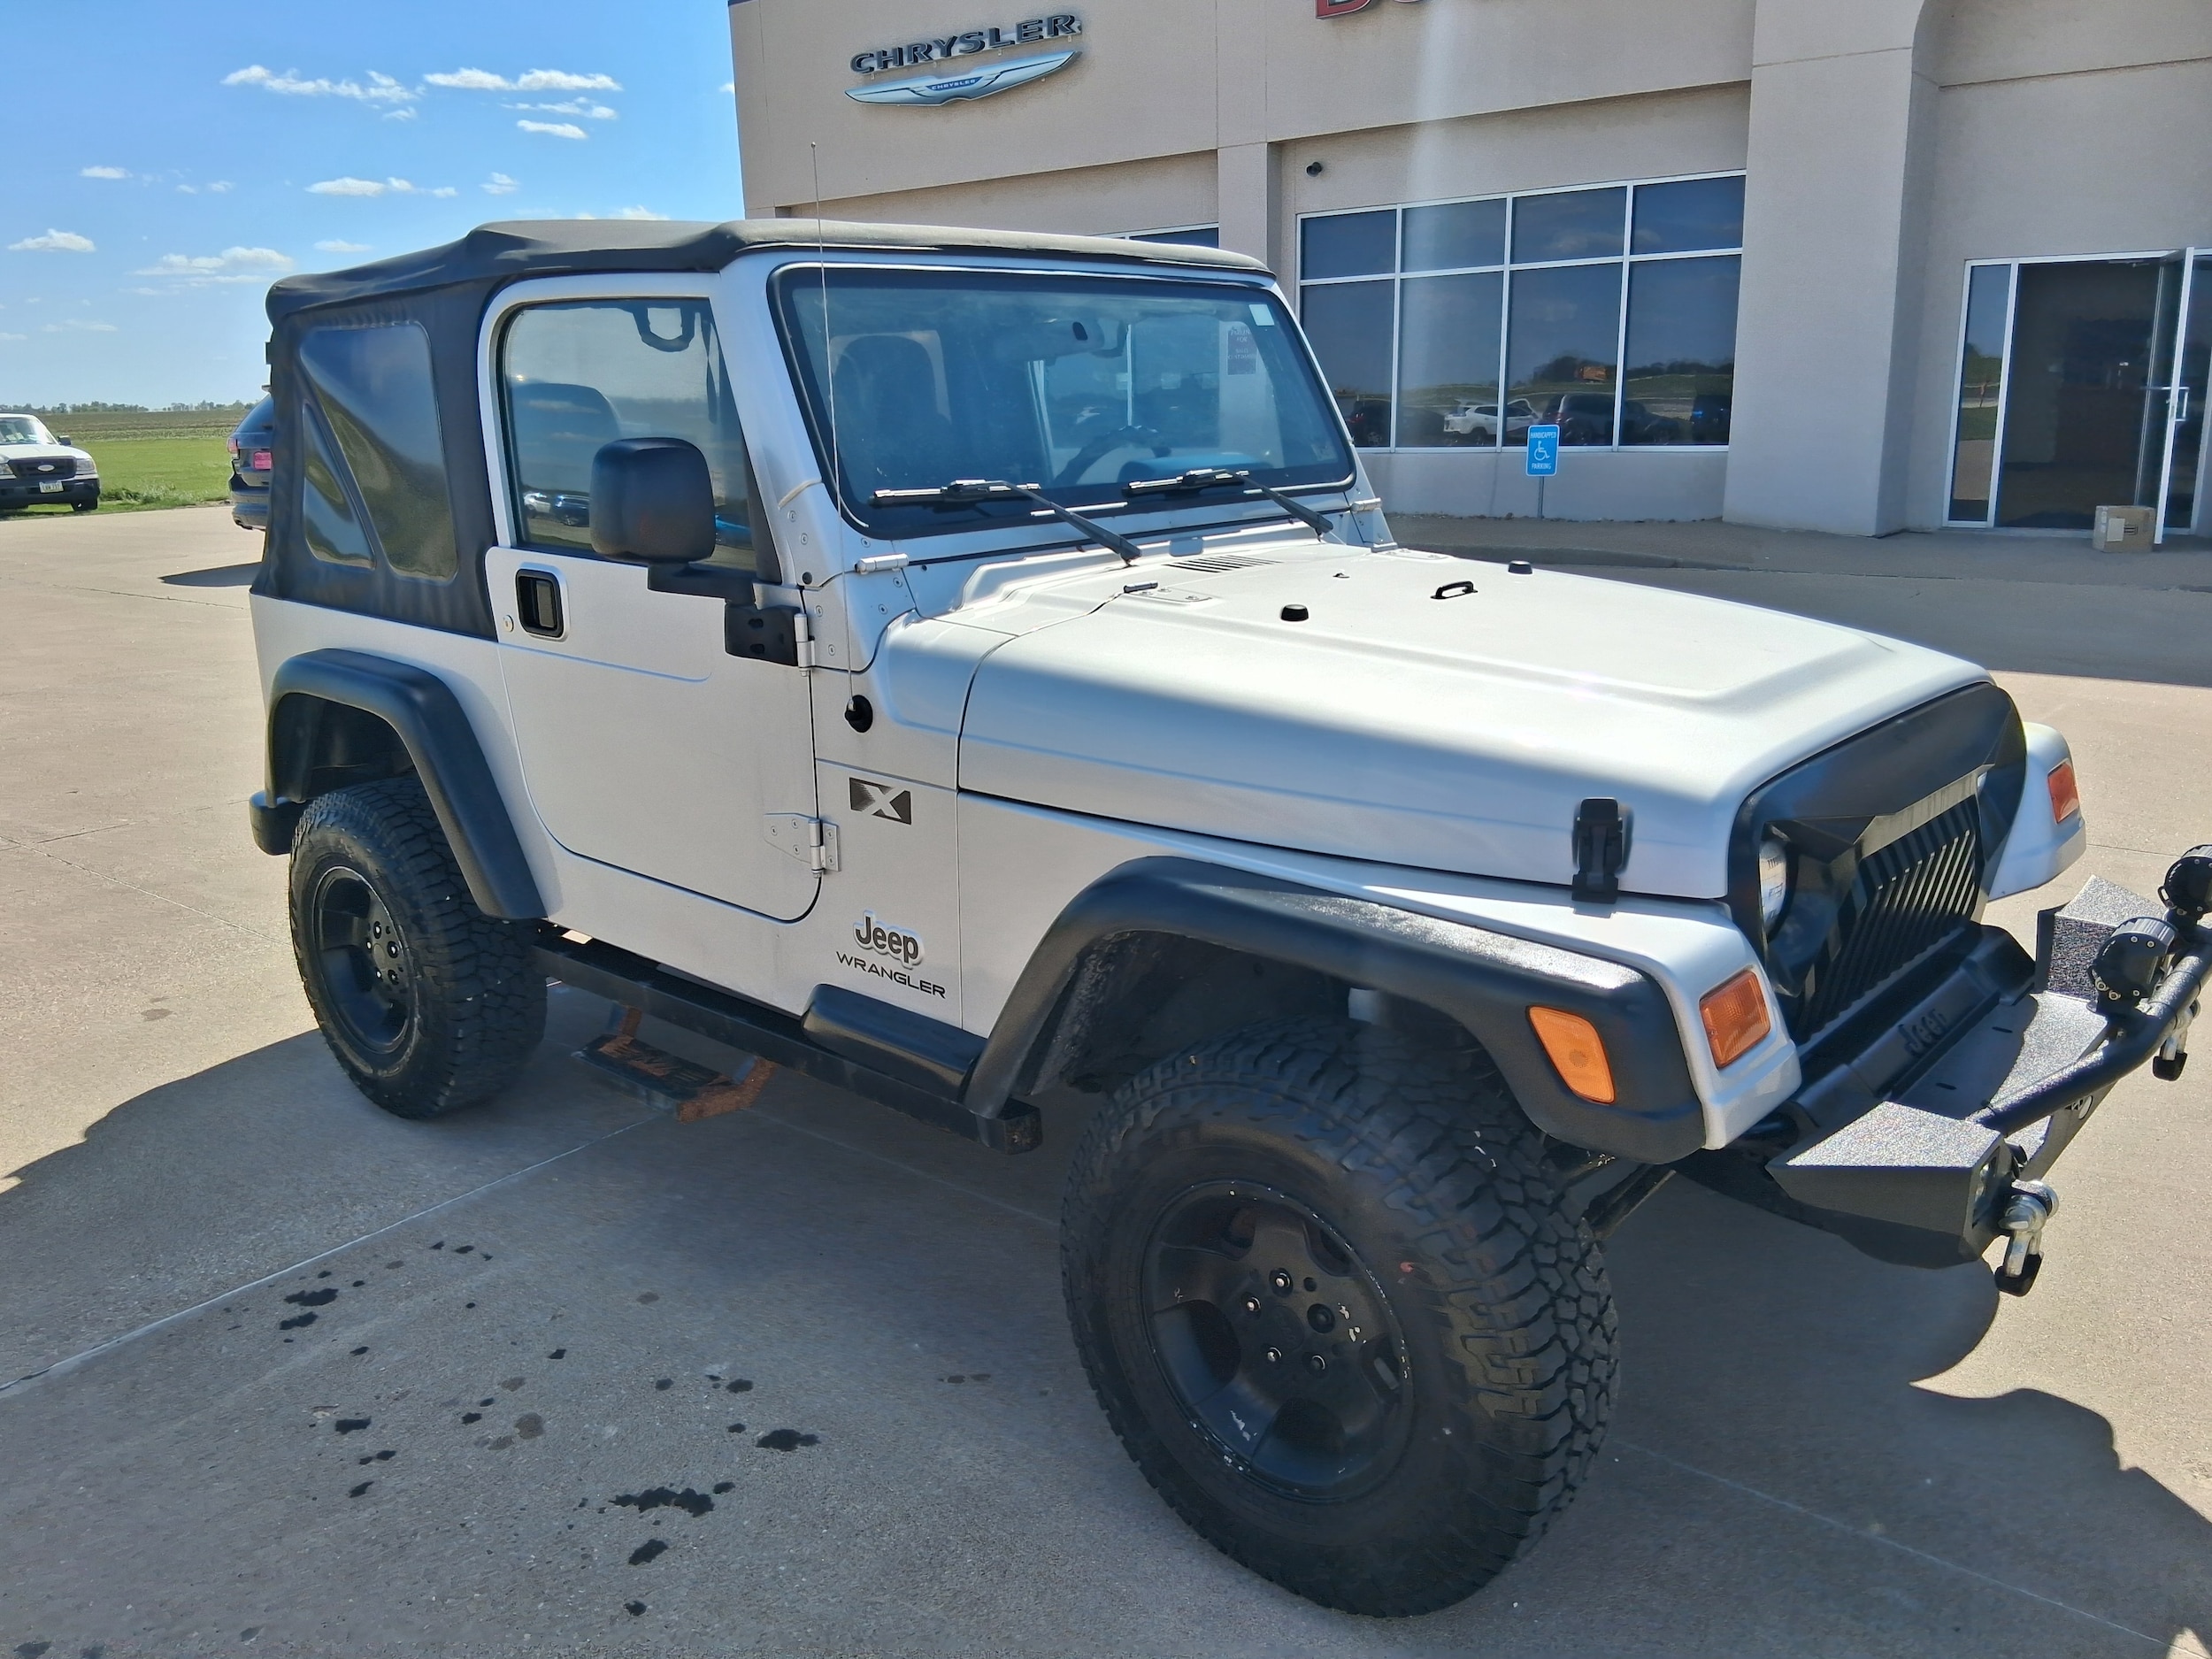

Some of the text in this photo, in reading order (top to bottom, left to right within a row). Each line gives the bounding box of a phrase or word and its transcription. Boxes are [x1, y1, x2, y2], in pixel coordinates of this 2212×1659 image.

[849, 14, 1079, 74] CHRYSLER
[931, 79, 976, 90] CHRYSLER
[849, 778, 911, 825] X
[855, 915, 919, 964] Jeep
[836, 951, 947, 999] WRANGLER
